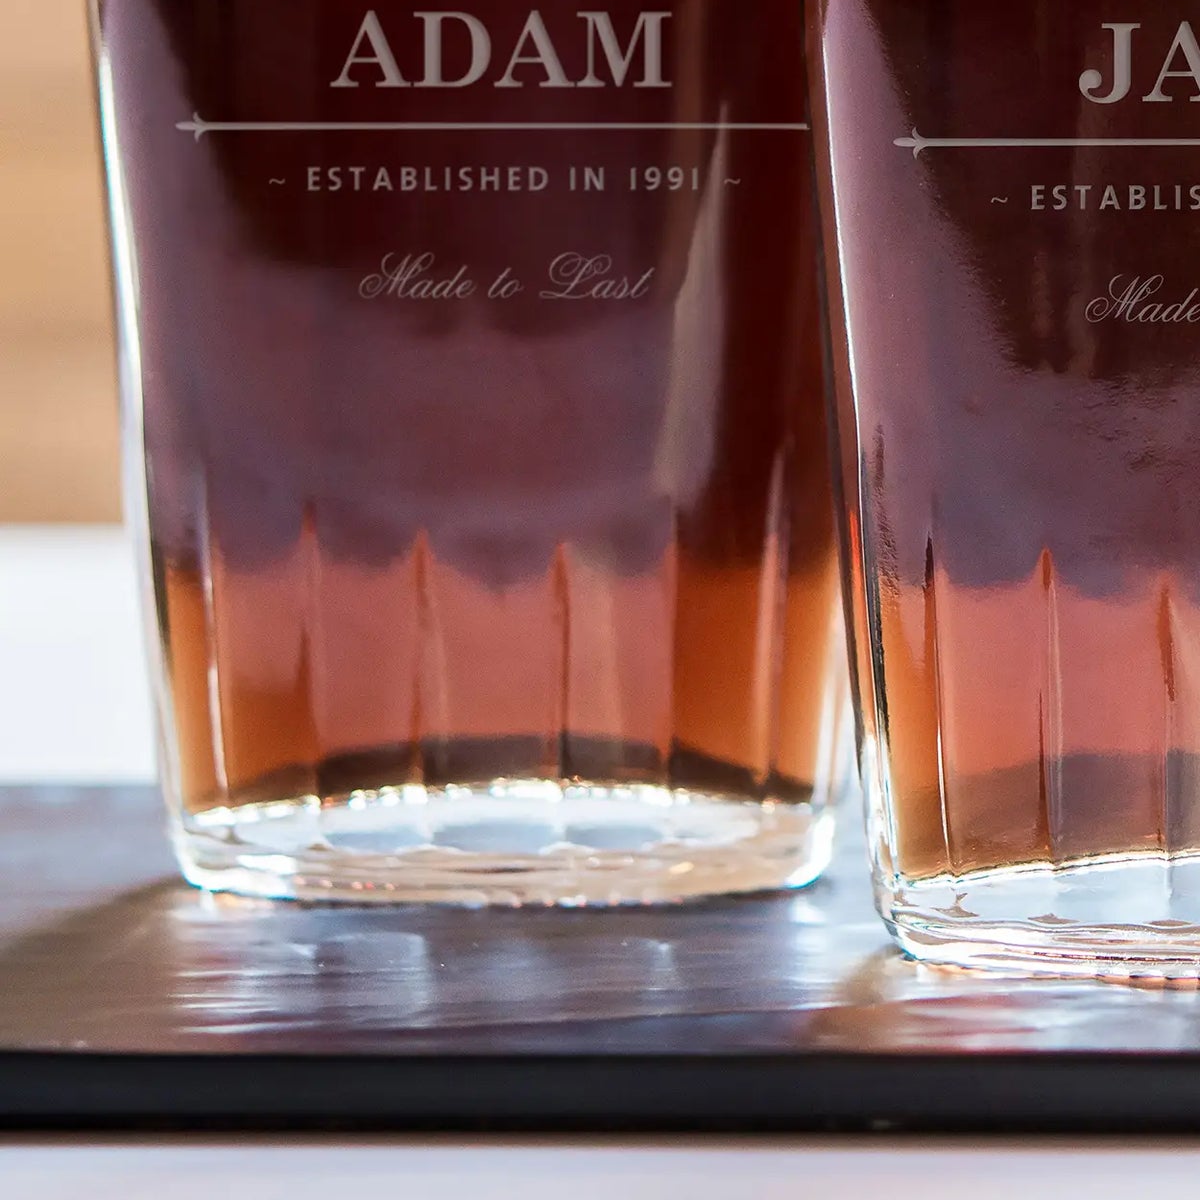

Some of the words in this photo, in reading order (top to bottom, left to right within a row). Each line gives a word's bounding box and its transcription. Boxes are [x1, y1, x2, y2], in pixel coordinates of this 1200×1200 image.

[329, 10, 672, 88] ADAM
[306, 166, 549, 192] ESTABLISHED
[569, 166, 605, 192] IN
[629, 166, 700, 192] 1991
[358, 251, 478, 300] Made
[488, 264, 524, 299] to
[539, 251, 656, 300] Last
